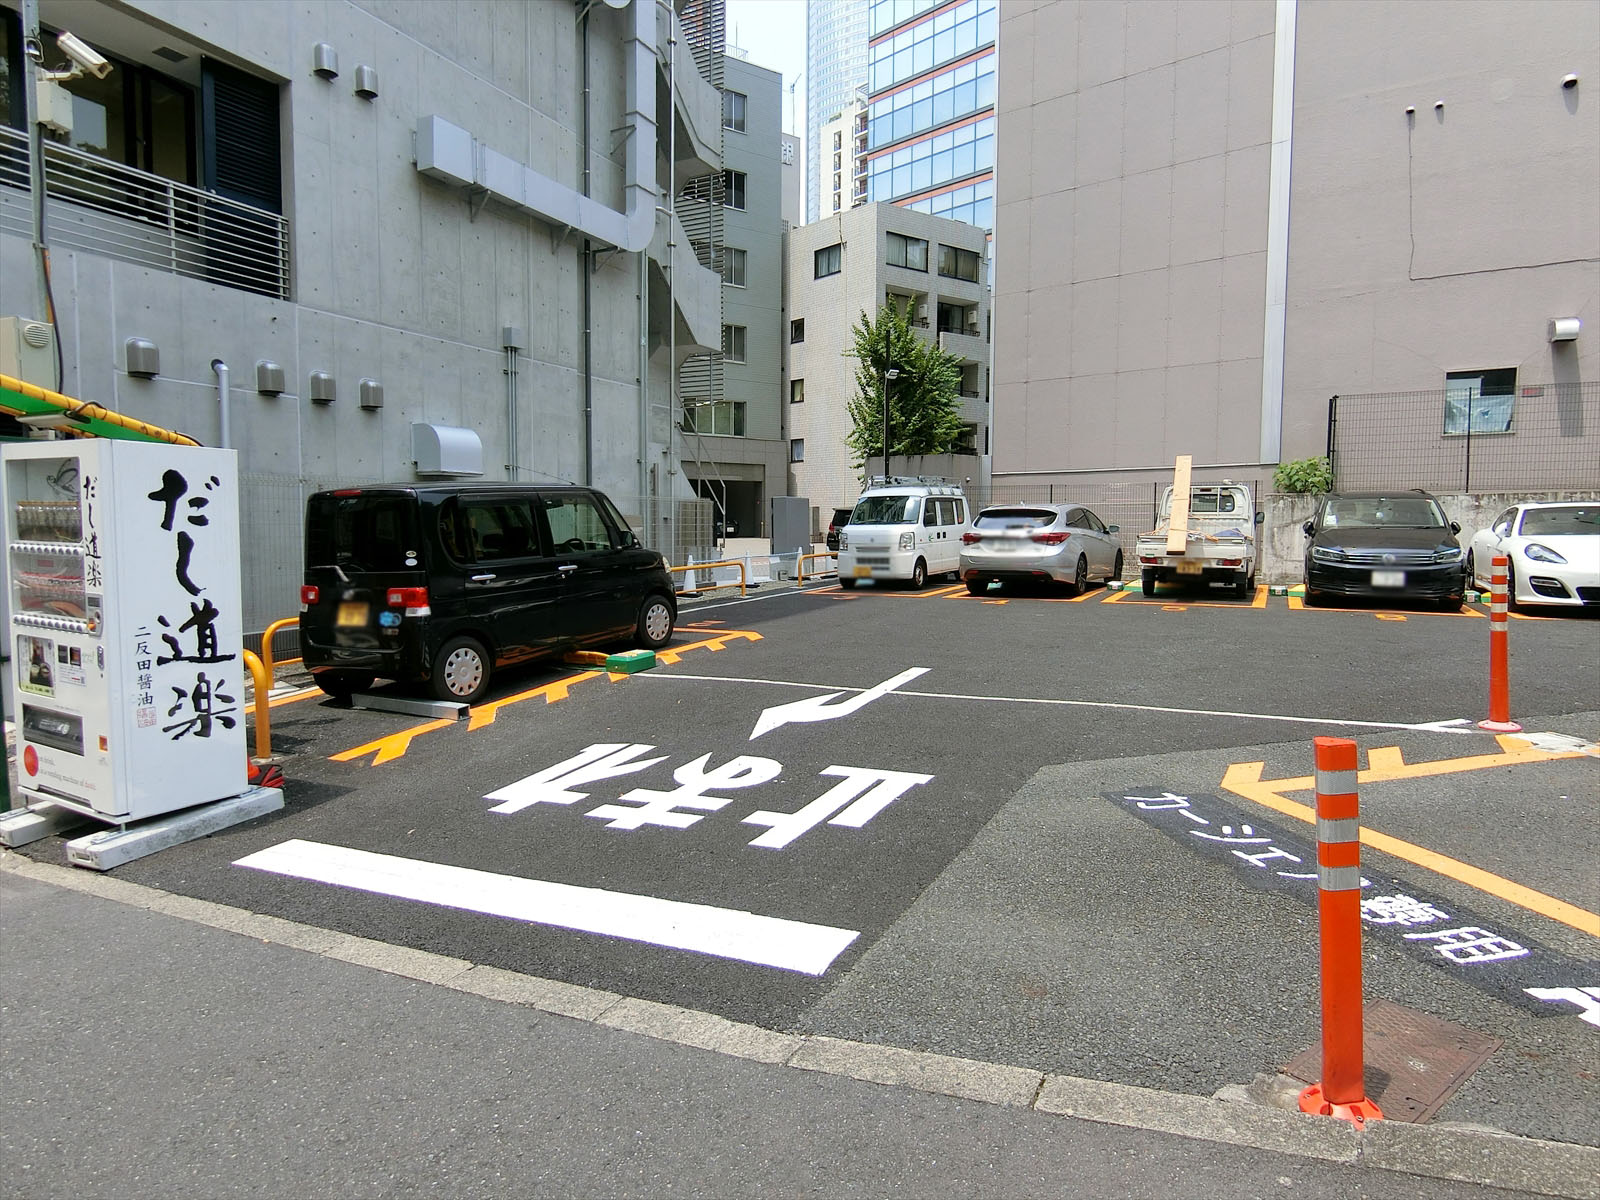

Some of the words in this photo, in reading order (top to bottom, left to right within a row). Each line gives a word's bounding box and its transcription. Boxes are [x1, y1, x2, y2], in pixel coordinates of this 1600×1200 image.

[83, 475, 102, 588] だし道楽
[148, 469, 237, 741] だし道楽
[482, 742, 935, 850] 止まれ
